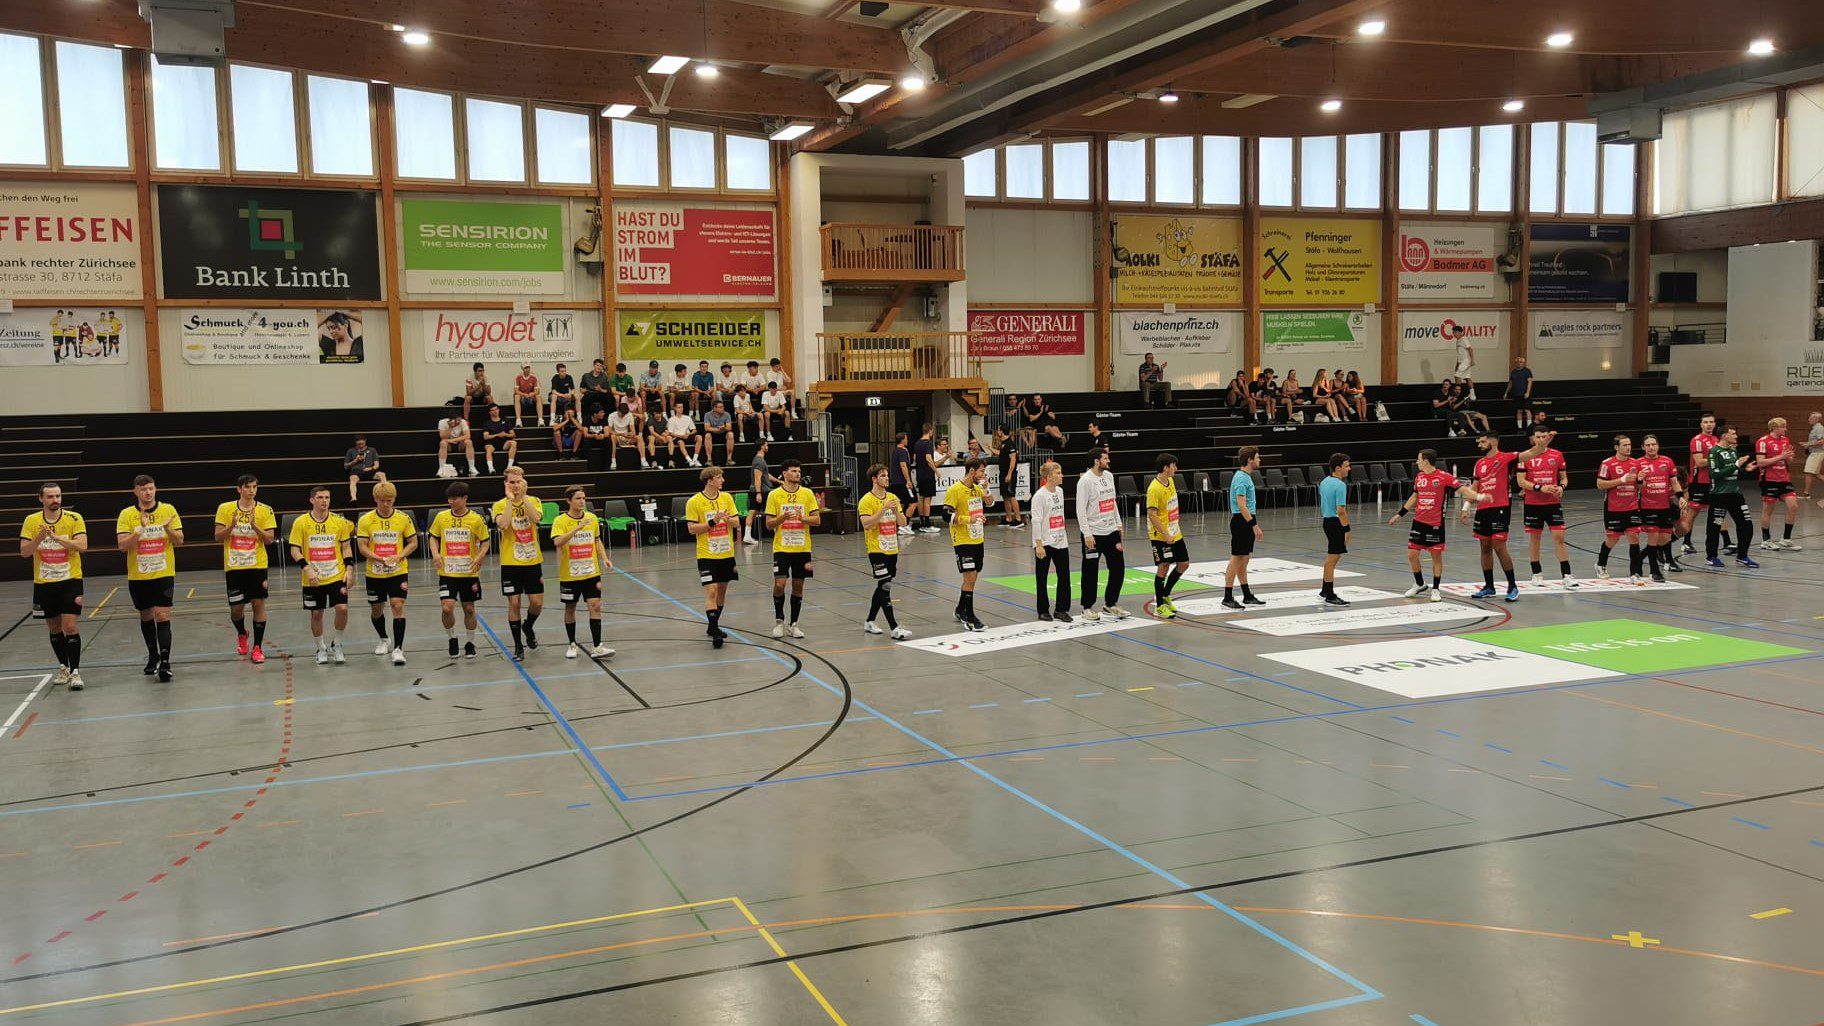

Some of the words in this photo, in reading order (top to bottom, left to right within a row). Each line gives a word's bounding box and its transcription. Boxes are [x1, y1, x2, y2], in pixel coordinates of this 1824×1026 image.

[41, 195, 61, 204] Weg
[64, 195, 79, 203] frei
[617, 211, 656, 227] HAST
[660, 213, 680, 227] DU
[419, 224, 548, 240] SENSIRION
[617, 230, 670, 244] STROM
[1305, 232, 1352, 244] Pfenninger
[420, 240, 443, 248] THE
[446, 241, 492, 249] SENSOR
[496, 242, 548, 250] COMPANY
[618, 249, 636, 262] IM
[1200, 251, 1241, 268] STÄFA
[31, 258, 75, 268] rechter
[79, 258, 136, 269] Zürichsee
[1434, 260, 1469, 270] Bodmer
[1472, 260, 1486, 269] AG
[40, 272, 58, 282] 30,
[62, 272, 90, 281] 8712
[95, 272, 123, 282] Stäfa
[195, 266, 269, 287] Bank
[274, 266, 351, 288] Linth
[618, 266, 666, 281] BLUT?
[429, 277, 542, 289] www.sensirion.com/jobs
[1264, 289, 1294, 297] Transporte
[184, 315, 244, 330] Schmuck
[996, 315, 1077, 332] GENERALI
[1133, 317, 1219, 332] blachenprinz.ch
[436, 313, 538, 349] hygolet
[656, 322, 761, 335] SCHNEIDER
[1552, 323, 1574, 333] eagles
[1576, 323, 1591, 331] rock
[1592, 323, 1622, 332] partners
[656, 340, 761, 348] UMWELTSERVICE.CH
[1007, 334, 1036, 345] Region
[1038, 333, 1077, 343] Zürichsee
[213, 343, 245, 351] Boutique
[264, 343, 303, 351] Onlineshop
[435, 350, 446, 358] Ihr
[449, 350, 480, 359] Partner
[482, 350, 493, 358] für
[496, 350, 575, 359] Waschraumhygiene
[1706, 440, 1713, 449] 5
[1720, 451, 1731, 460] 12
[1530, 458, 1542, 468] 17
[1616, 466, 1624, 474] 6
[1641, 464, 1654, 473] 21
[1416, 478, 1428, 487] 20
[787, 494, 797, 503] 22
[239, 513, 250, 523] 25
[452, 518, 462, 528] 33
[315, 524, 326, 534] 94
[1333, 651, 1521, 675] PHONAK
